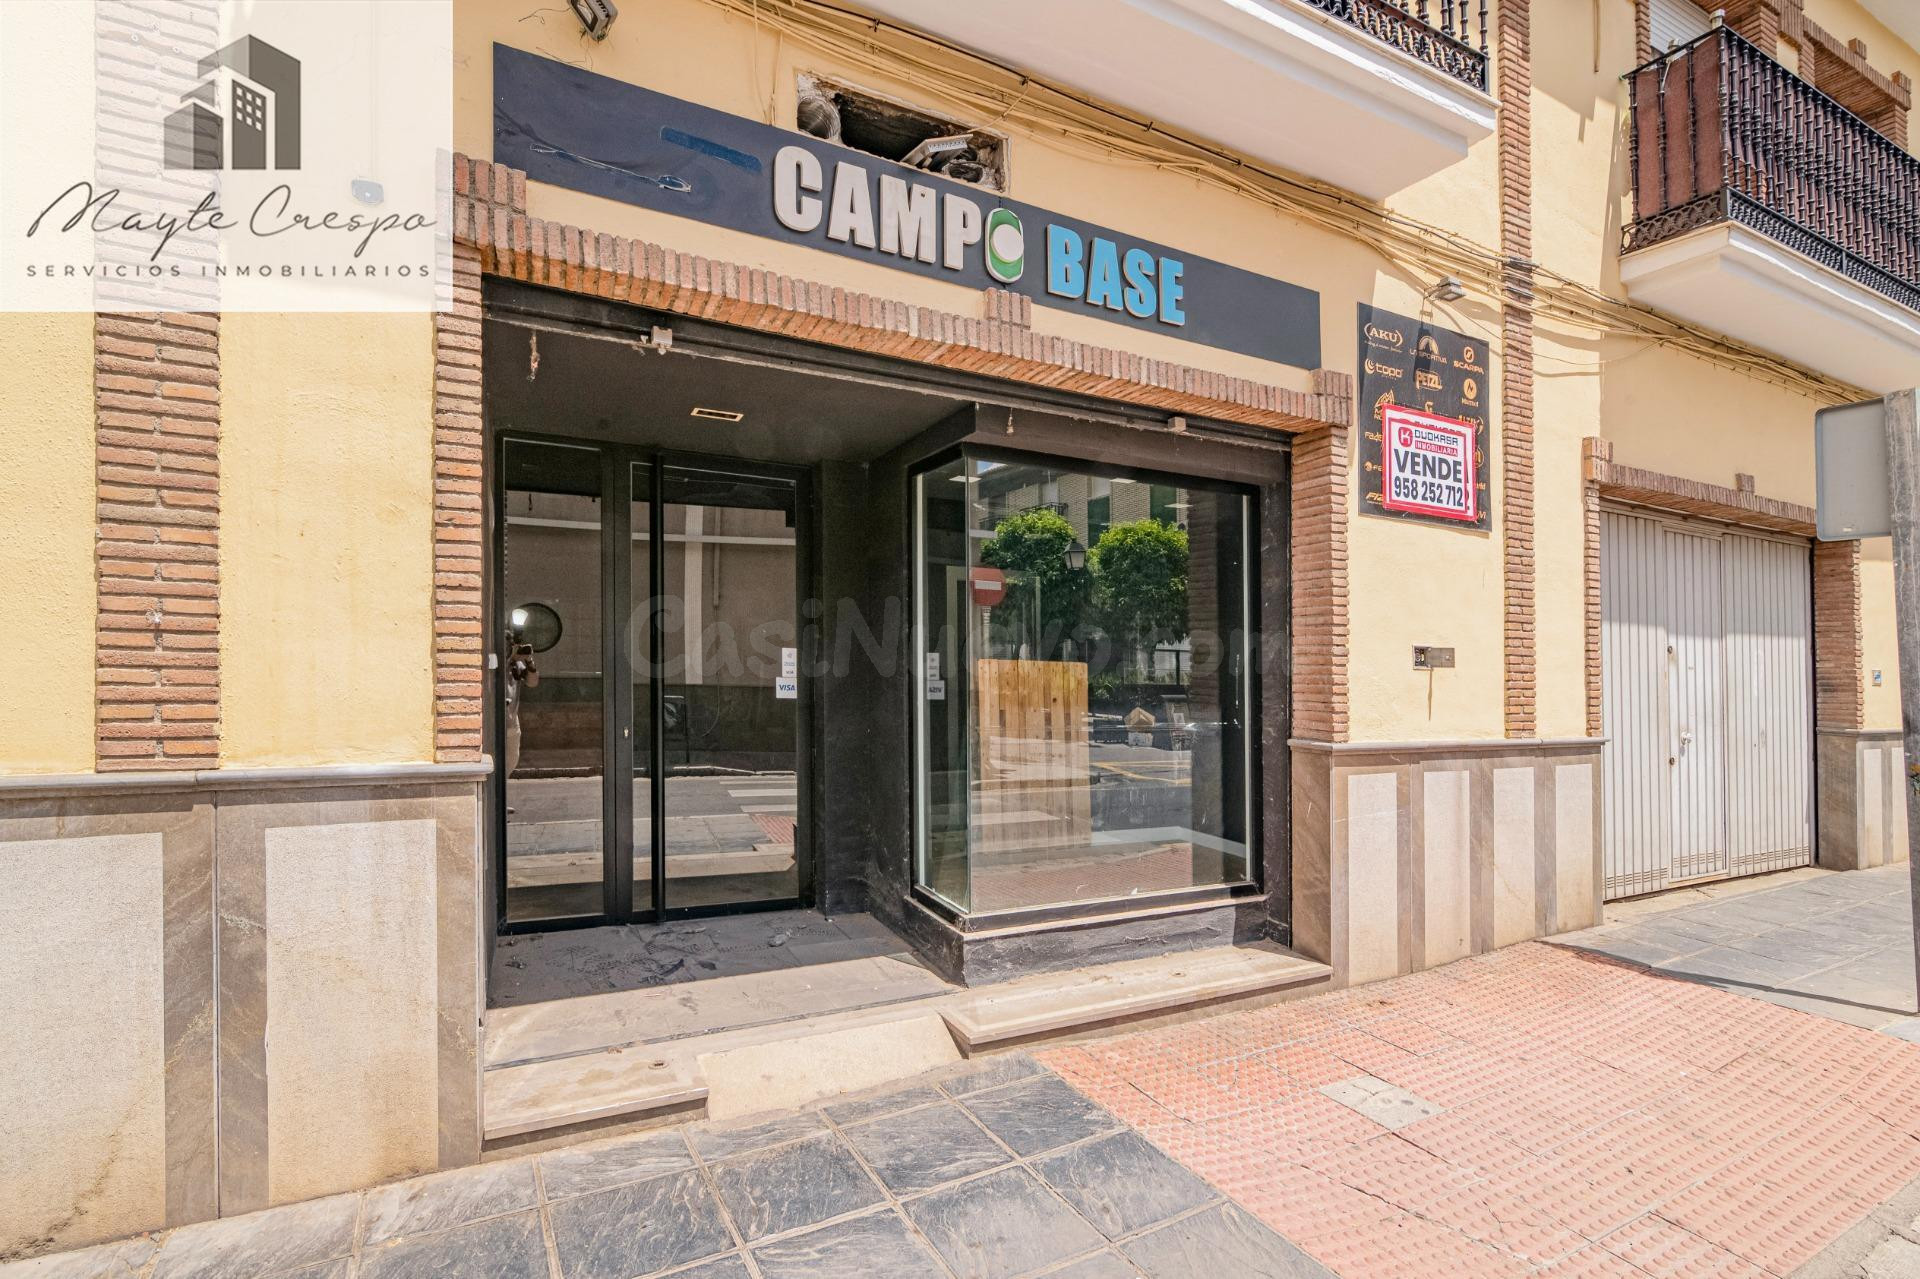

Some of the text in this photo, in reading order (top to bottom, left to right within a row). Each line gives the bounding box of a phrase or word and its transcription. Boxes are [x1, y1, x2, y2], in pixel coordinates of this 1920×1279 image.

[773, 145, 1186, 326] CAMPO BASE
[1415, 441, 1459, 456] INMOBILIARIA
[1393, 449, 1463, 483] VENDE
[1394, 476, 1464, 507] 958 252 712
[779, 684, 796, 692] VISA
